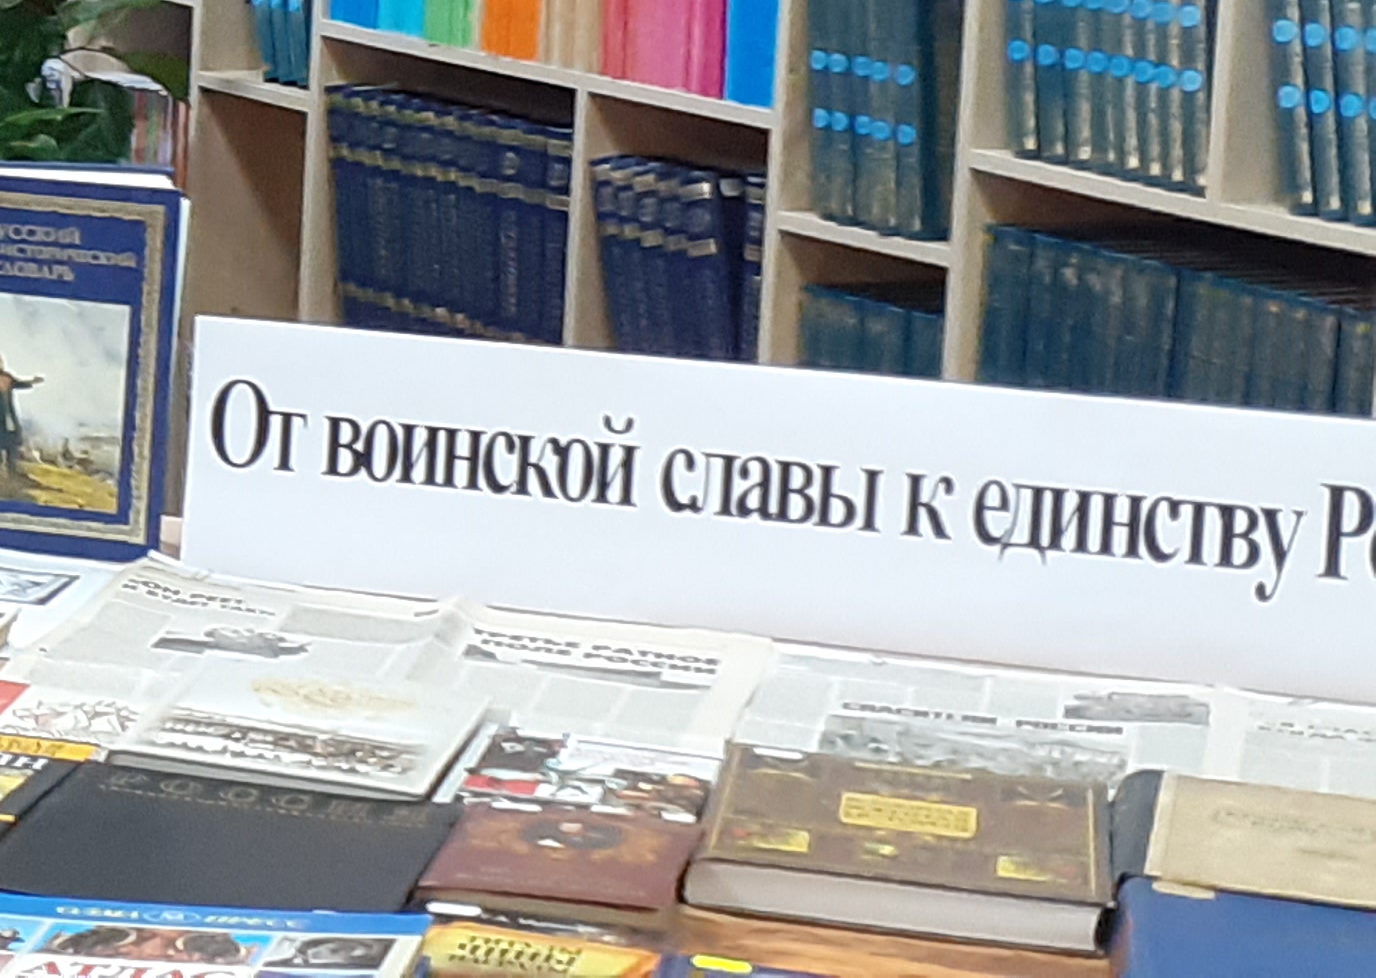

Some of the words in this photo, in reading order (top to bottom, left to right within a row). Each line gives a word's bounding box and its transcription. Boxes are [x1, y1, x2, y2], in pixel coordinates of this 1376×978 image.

[210, 378, 308, 473] От
[323, 415, 638, 508] воинской
[660, 447, 882, 533] славы
[903, 472, 955, 540] к
[972, 479, 1308, 604] единству
[1314, 483, 1376, 581] Р
[480, 638, 571, 657] ПОЛЕ
[582, 651, 717, 675] РОССИИ
